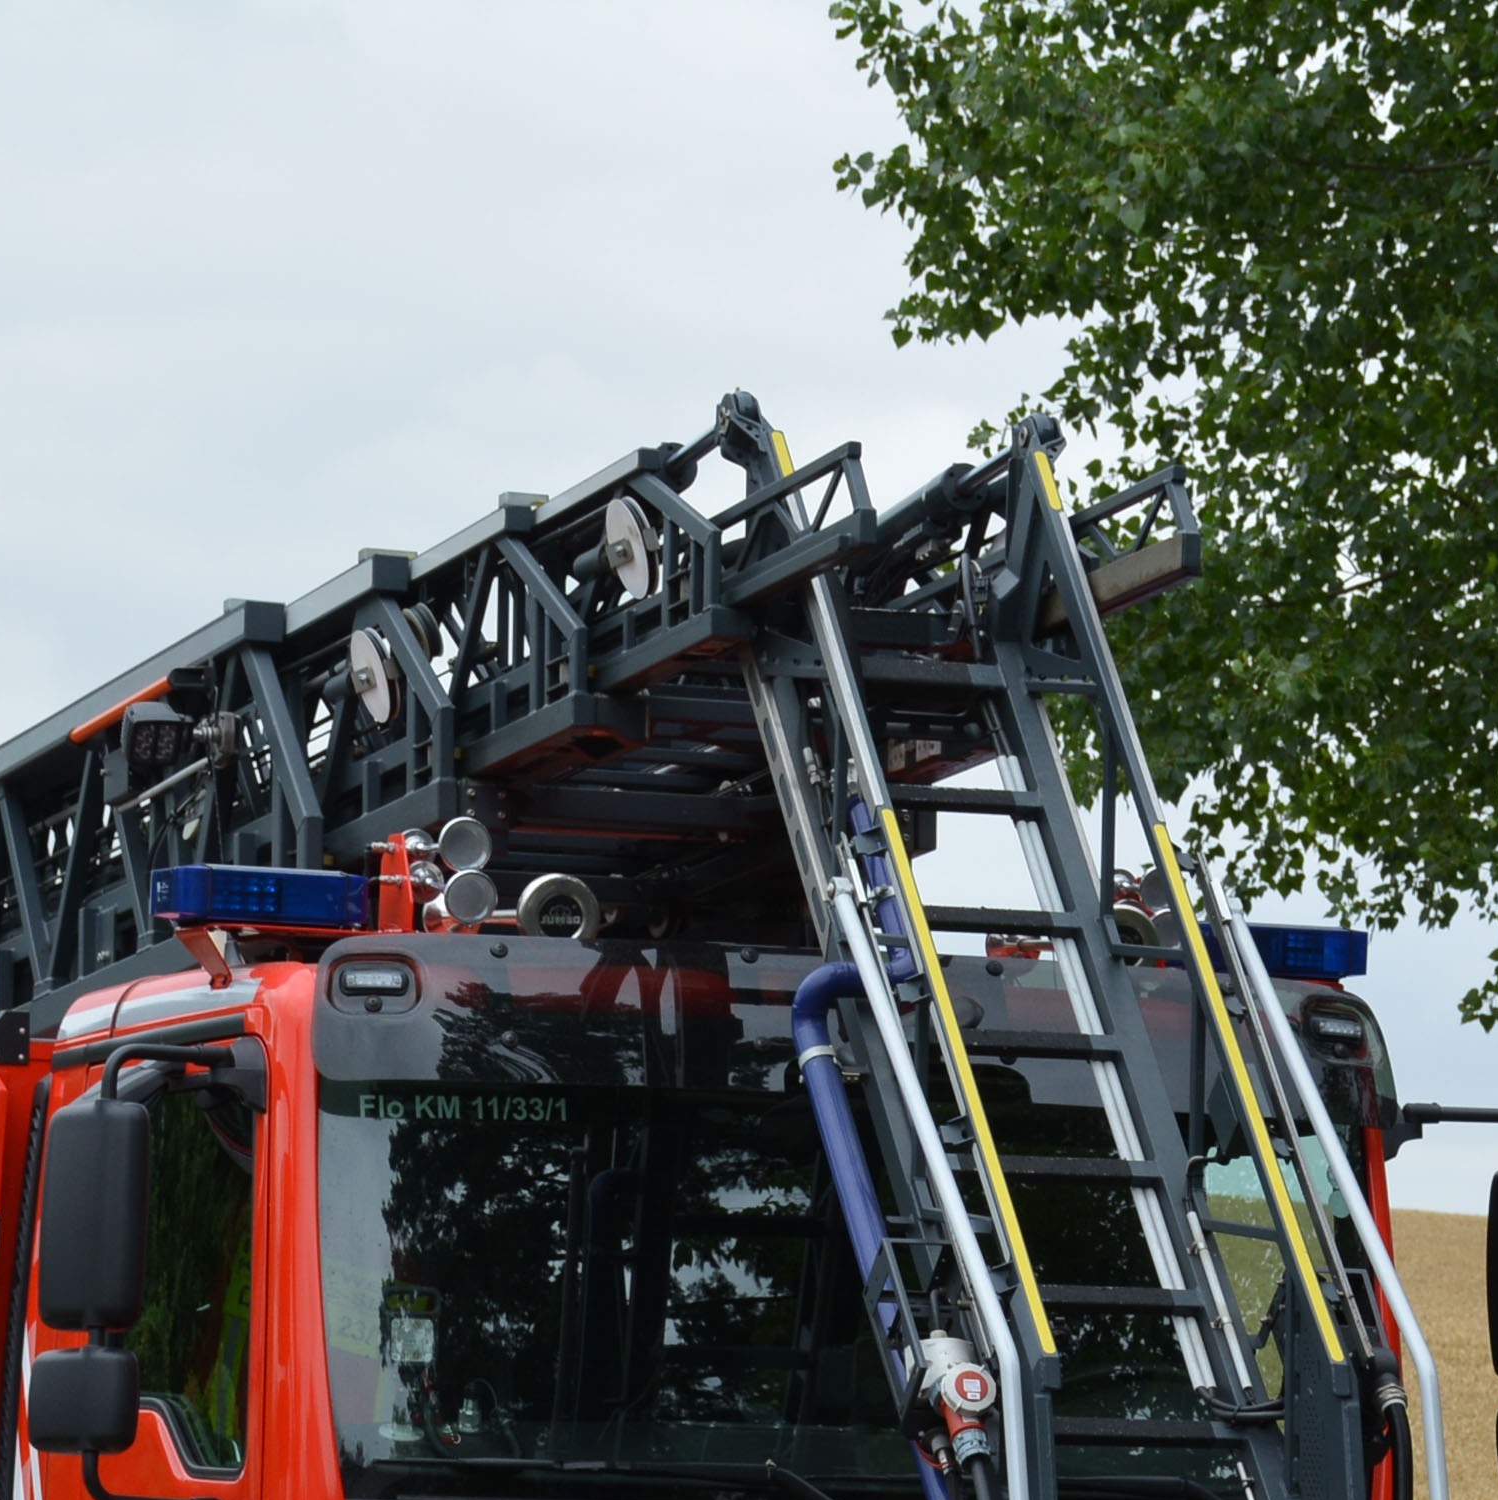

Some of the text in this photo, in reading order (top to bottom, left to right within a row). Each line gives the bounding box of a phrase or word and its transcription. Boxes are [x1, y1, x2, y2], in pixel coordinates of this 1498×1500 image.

[359, 1095, 568, 1122] Flo KM 11/33/1
